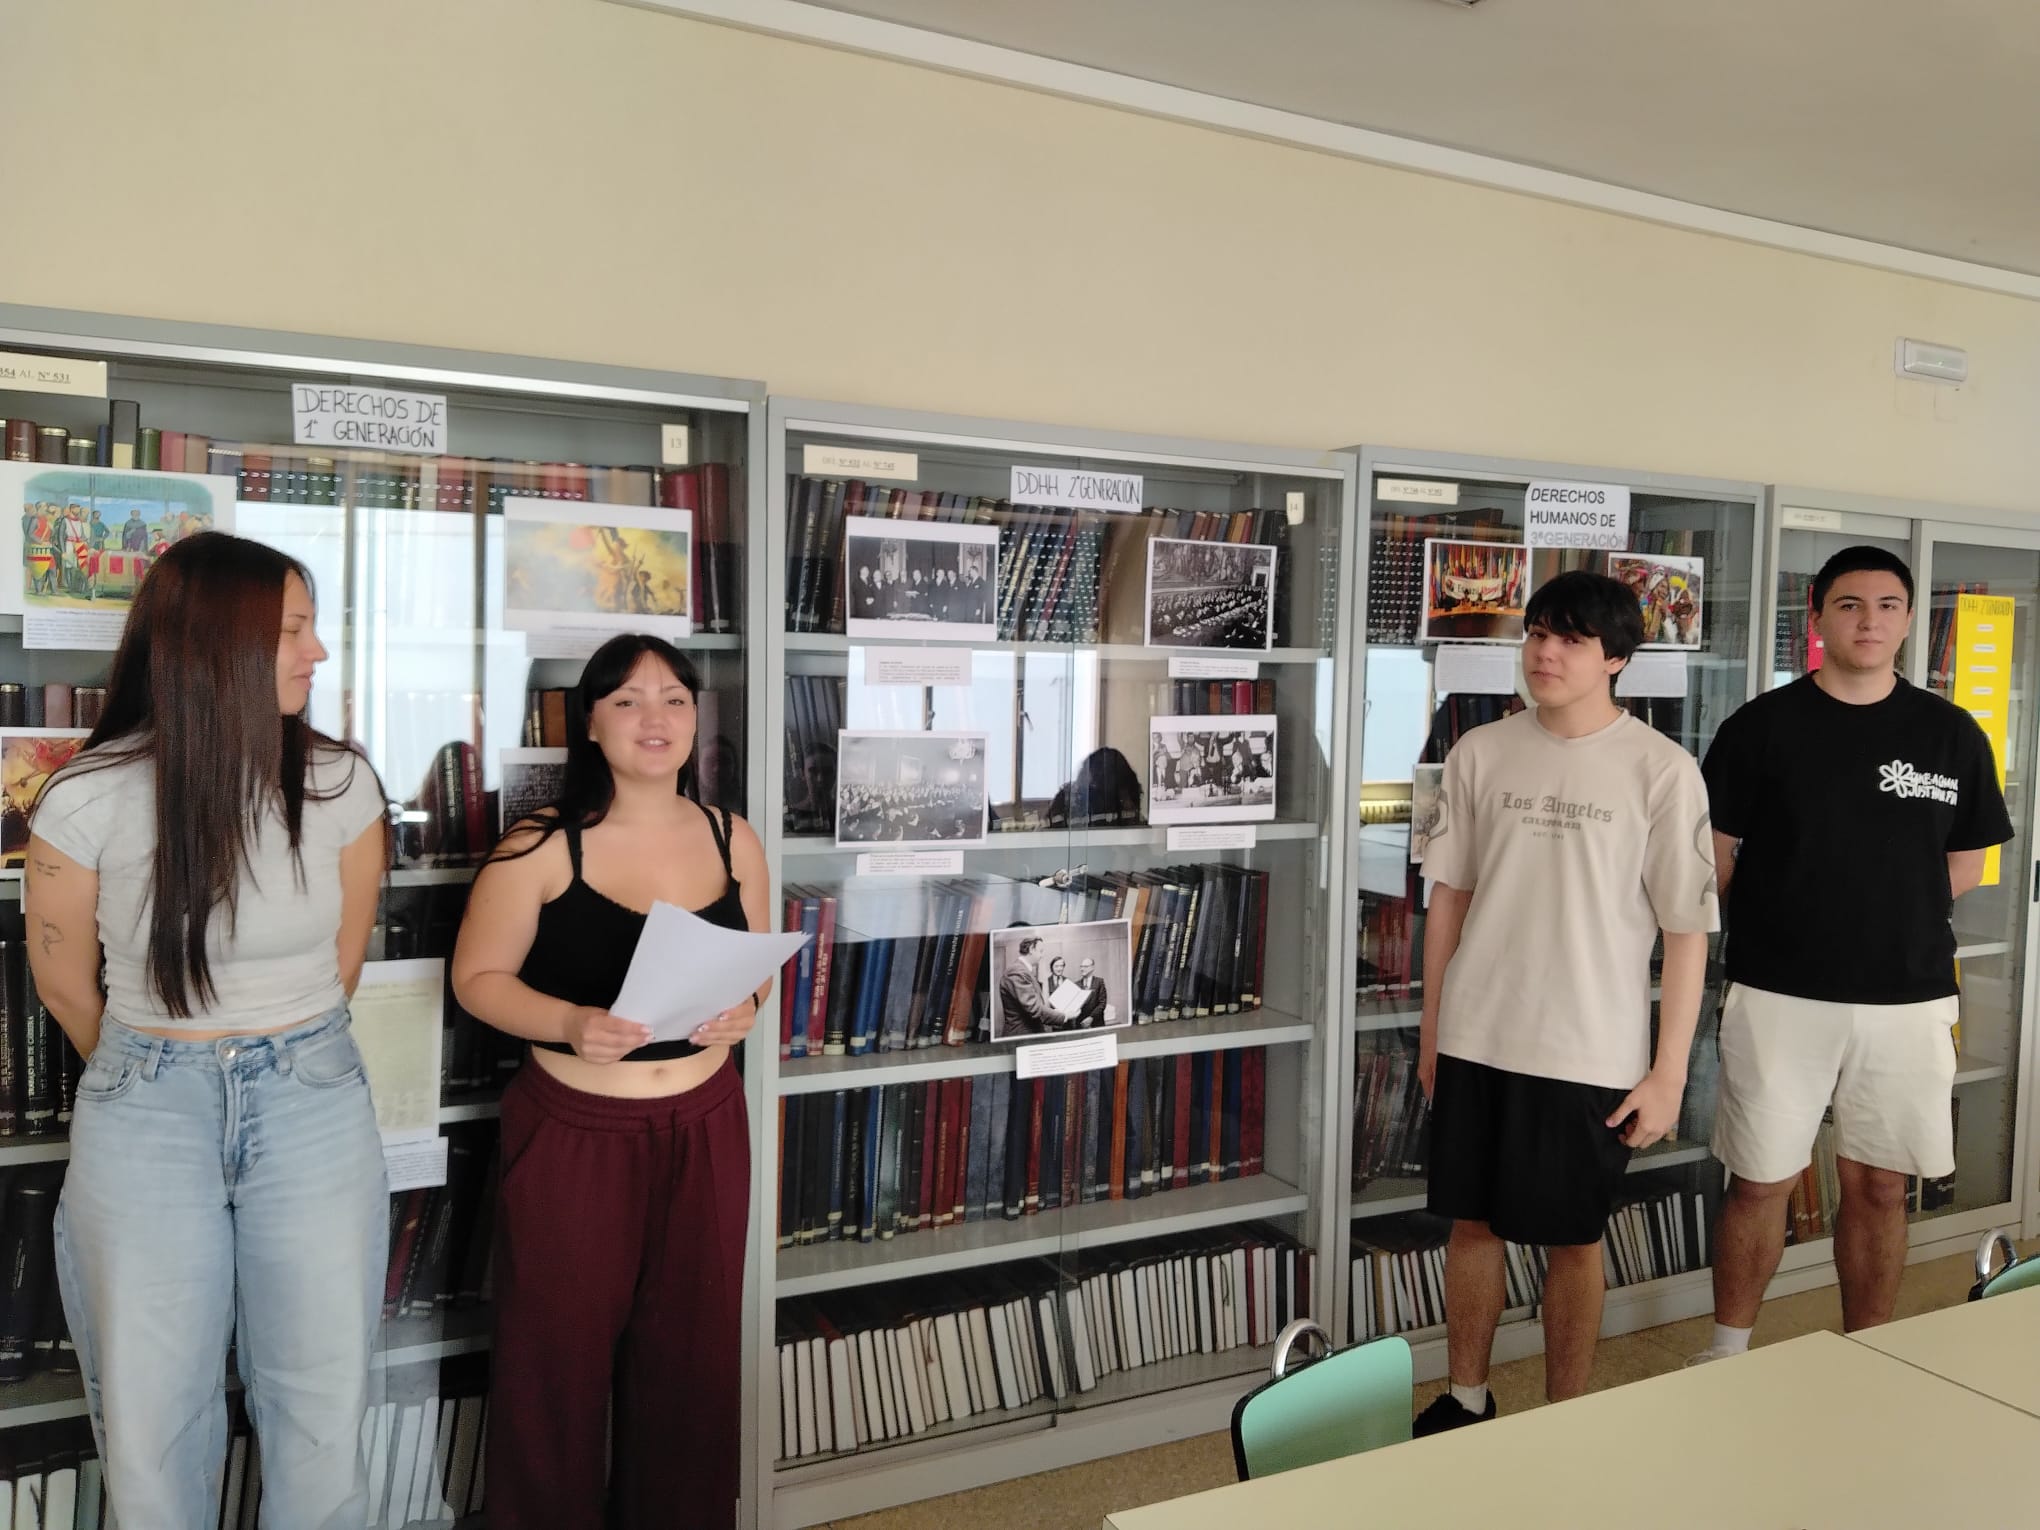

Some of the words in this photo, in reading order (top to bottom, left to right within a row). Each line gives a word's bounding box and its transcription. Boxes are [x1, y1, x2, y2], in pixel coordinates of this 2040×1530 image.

[297, 388, 409, 420] DERECHOS
[416, 400, 445, 426] DE
[1016, 471, 1059, 497] DDHH
[1531, 488, 1605, 504] DERECHOS
[1530, 510, 1598, 526] HUMANOS
[1600, 514, 1616, 528] DE
[1502, 791, 1533, 810] Los
[1541, 795, 1614, 823] Angeles
